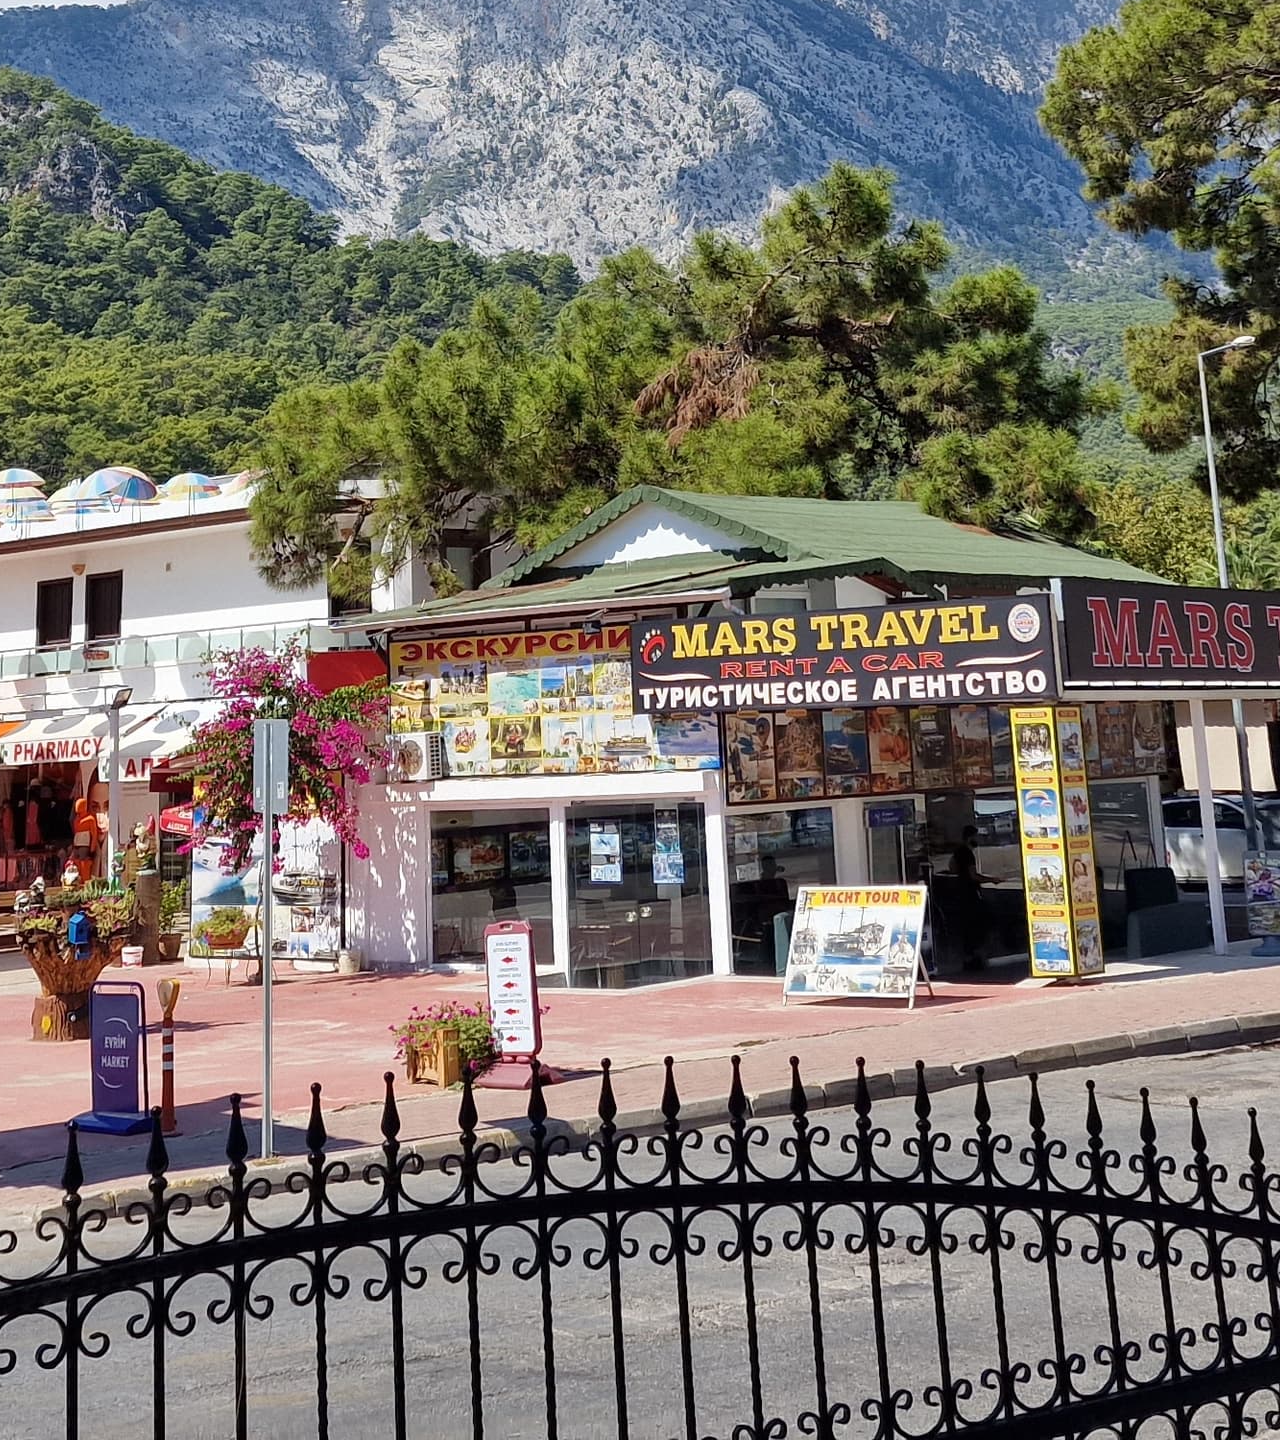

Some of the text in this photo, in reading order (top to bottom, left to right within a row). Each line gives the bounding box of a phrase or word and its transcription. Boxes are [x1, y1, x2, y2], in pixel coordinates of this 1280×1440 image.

[811, 605, 999, 650] TRAVEL
[399, 627, 632, 662] ЭКСКУРСИИ
[720, 650, 945, 678] RENT A CAR
[639, 670, 1047, 710] ТУРИСТИЧЕСКОЕ АГЕНТСТВО
[13, 736, 104, 761] PHARMACY
[821, 891, 900, 904] YACHT TOUR
[101, 1055, 129, 1068] MARKET
